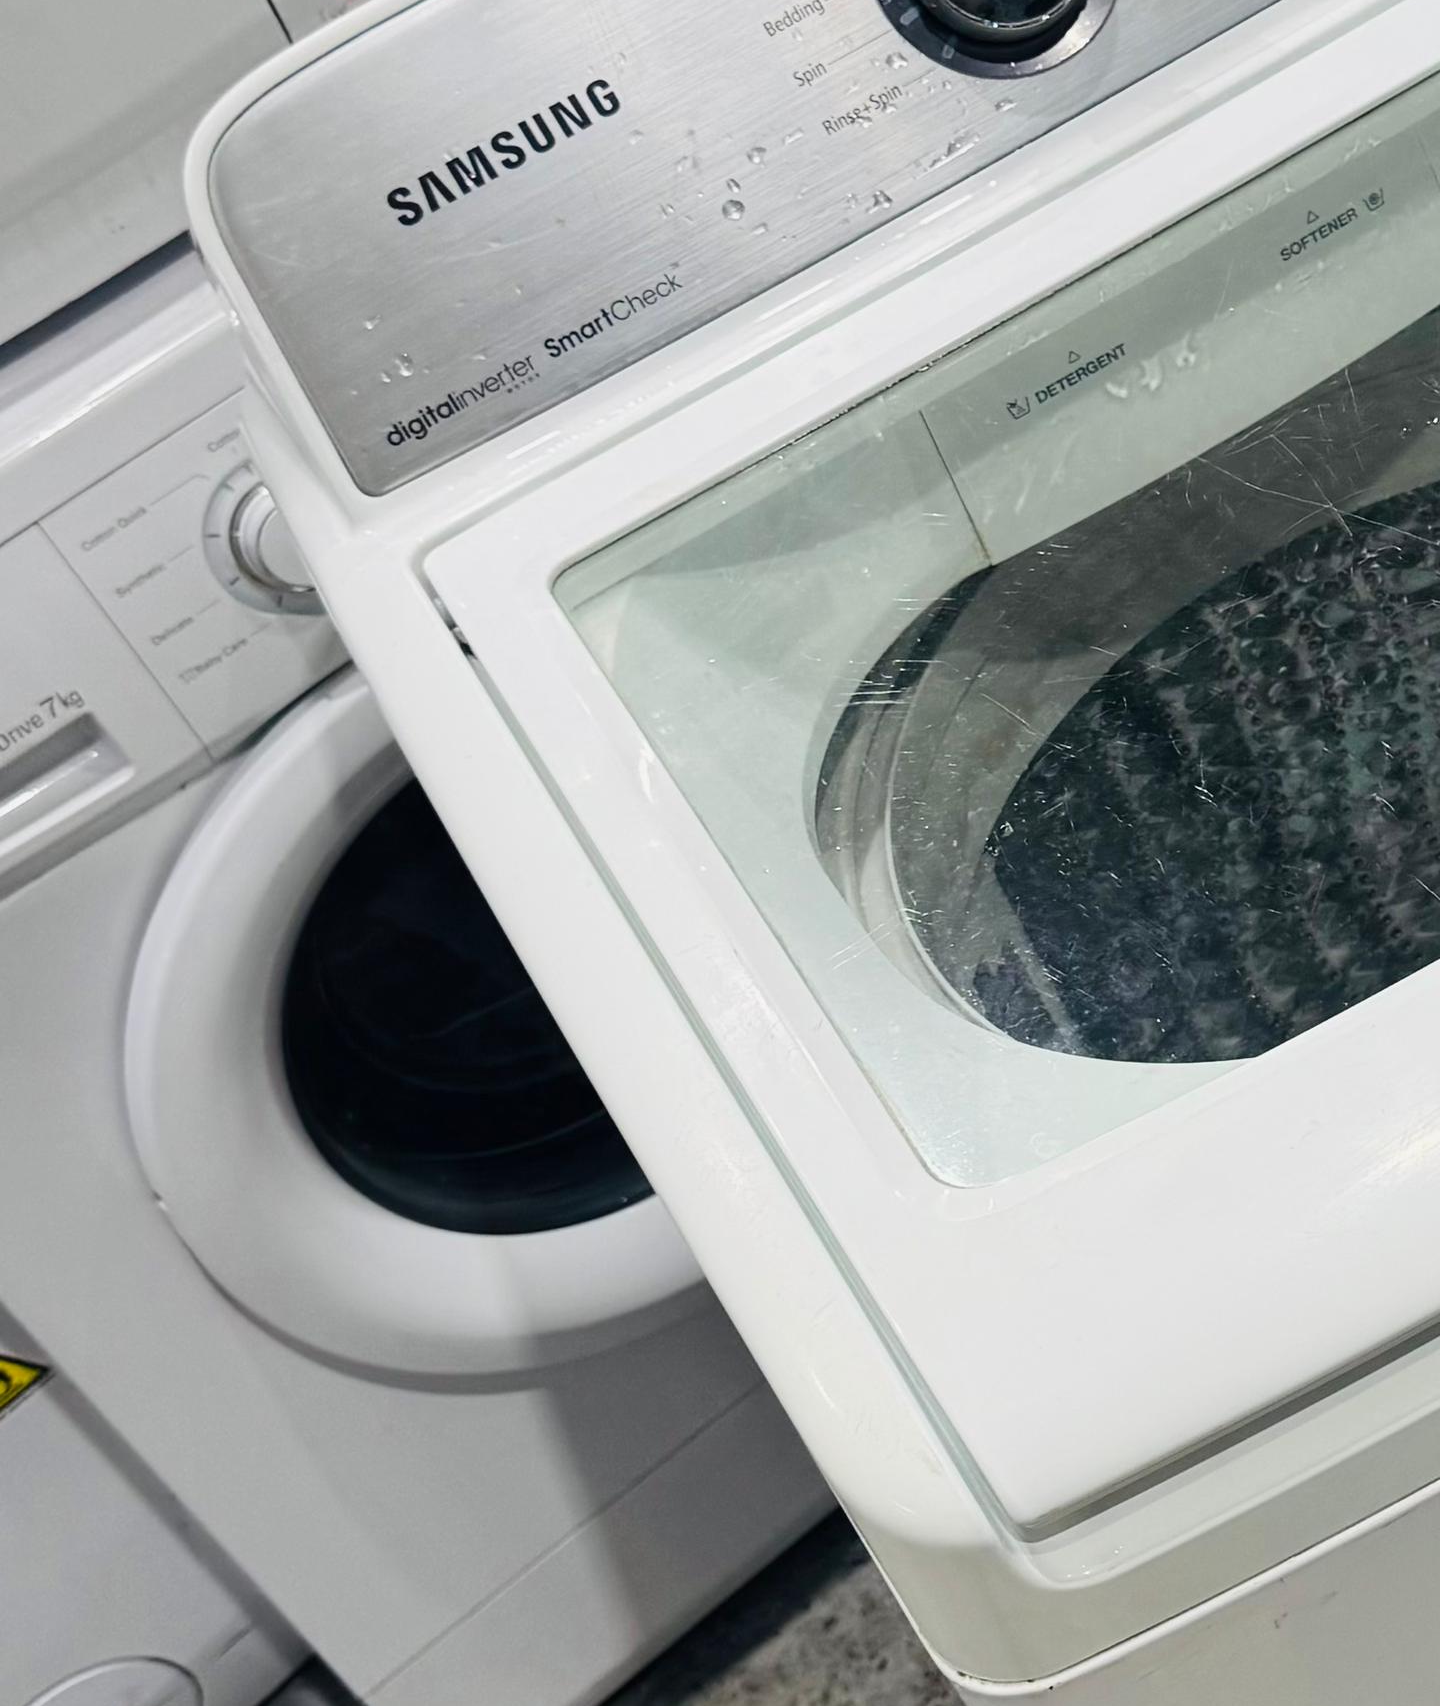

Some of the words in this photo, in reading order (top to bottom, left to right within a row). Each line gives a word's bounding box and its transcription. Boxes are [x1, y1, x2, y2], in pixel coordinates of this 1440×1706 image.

[792, 59, 830, 90] Spin
[821, 82, 905, 137] Rinse+Spin
[386, 78, 622, 227] SAMSUNG
[1279, 207, 1359, 263] SOFTENER
[385, 354, 537, 448] digitalinverter
[543, 273, 684, 359] SmartCheck
[1034, 342, 1128, 406] DETERGENT
